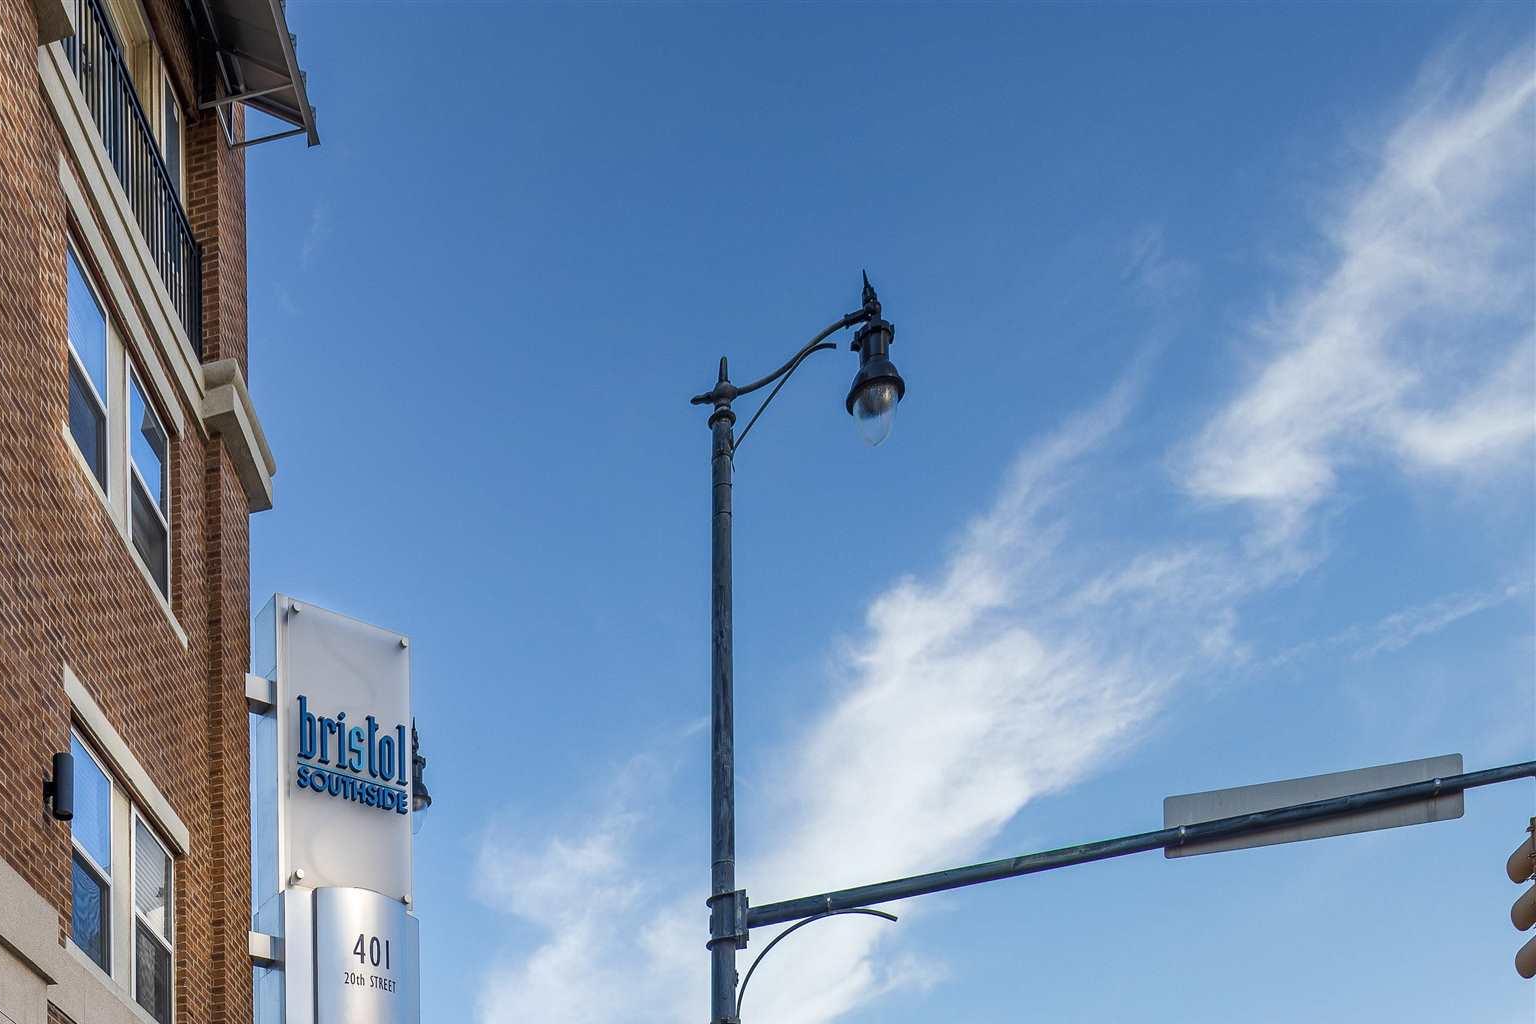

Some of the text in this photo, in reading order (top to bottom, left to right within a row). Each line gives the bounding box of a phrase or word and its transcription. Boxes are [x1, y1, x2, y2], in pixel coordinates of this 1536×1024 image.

[296, 694, 408, 786] bristol
[296, 764, 409, 815] SOUTHSIDE
[352, 933, 390, 970] 401
[344, 971, 396, 993] 20th STREET
